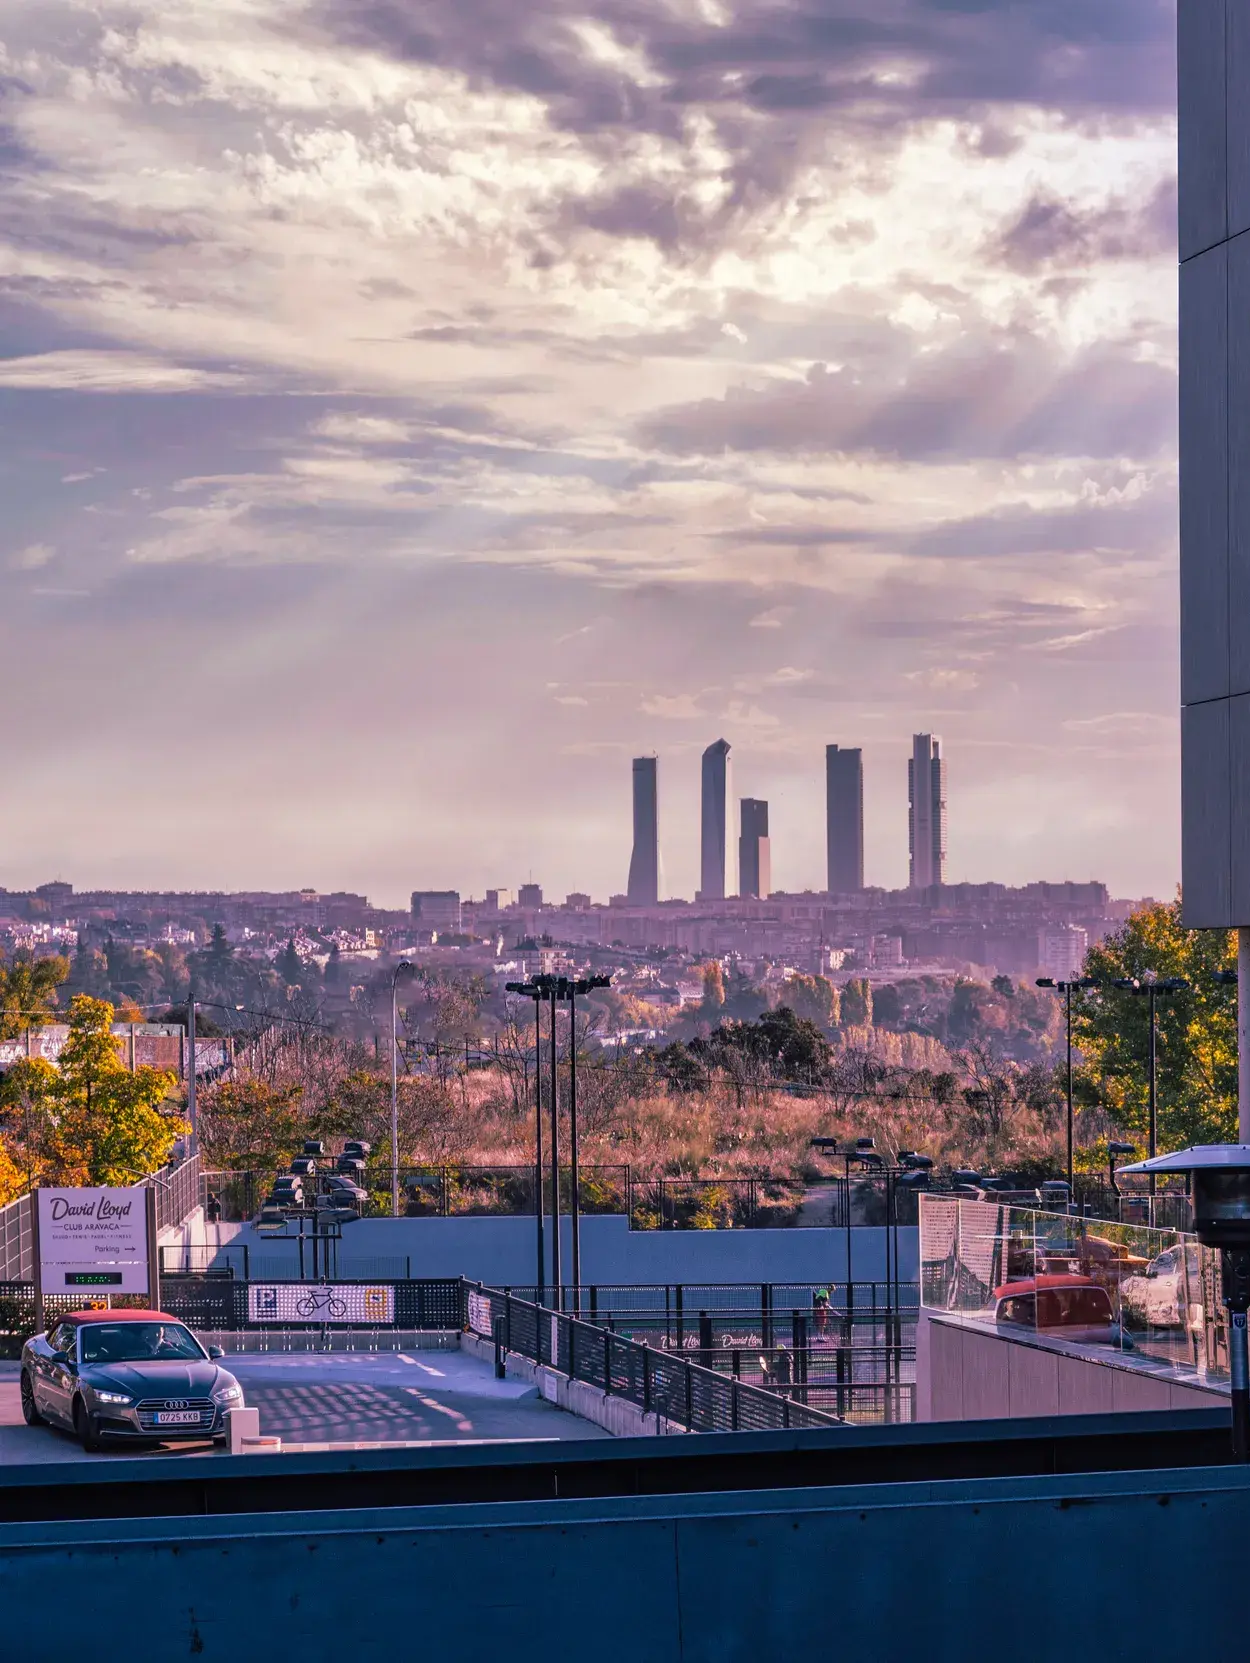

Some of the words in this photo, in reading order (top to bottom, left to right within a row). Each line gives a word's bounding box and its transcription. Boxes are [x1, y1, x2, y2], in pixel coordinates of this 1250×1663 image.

[50, 1197, 95, 1220] David
[96, 1196, 132, 1220] Lloyd
[64, 1223, 83, 1231] CLUB
[84, 1223, 120, 1231] ARAVACA
[94, 1245, 120, 1254] Parking
[160, 1413, 181, 1422] 0725
[183, 1412, 199, 1421] KKB
